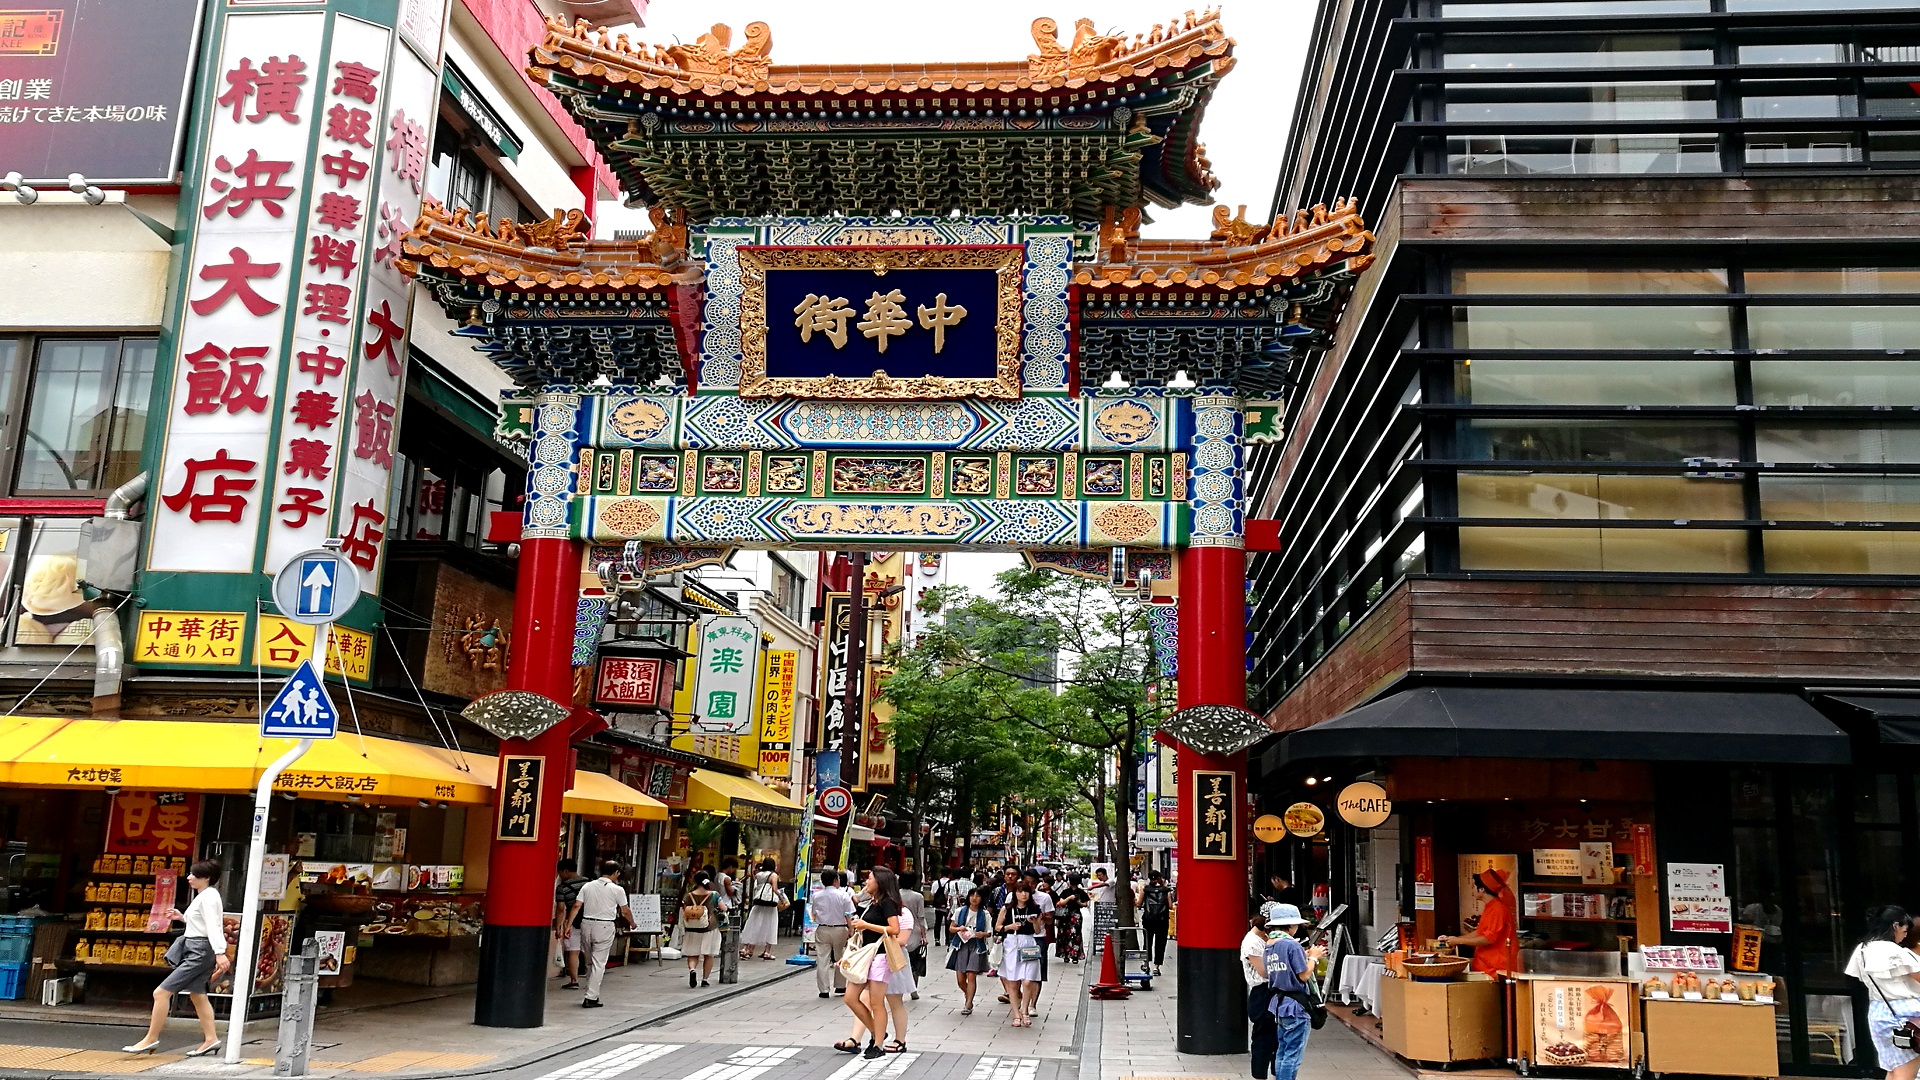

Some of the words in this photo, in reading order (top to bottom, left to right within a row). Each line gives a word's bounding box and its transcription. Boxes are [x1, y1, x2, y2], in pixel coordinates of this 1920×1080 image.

[0, 78, 53, 100] 創業
[162, 54, 307, 524] 横浜大飯店
[278, 61, 381, 529] 高級中華料理・中華菓子
[794, 288, 968, 354] 中華街
[148, 616, 240, 642] 中華街
[143, 643, 236, 659] 大通り入口
[266, 622, 307, 664] 入口
[606, 661, 654, 681] 横濱
[601, 680, 652, 700] 大飯店
[707, 647, 744, 719] 楽園
[764, 654, 781, 737] 世界一の肉まん
[777, 651, 795, 741] 中国料理世界チャンピオン
[761, 752, 789, 763] 100円
[67, 766, 122, 783] 大粒甘栗
[274, 772, 378, 792] 横浜大飯店
[827, 795, 845, 808] 30
[1359, 798, 1388, 812] CAFE
